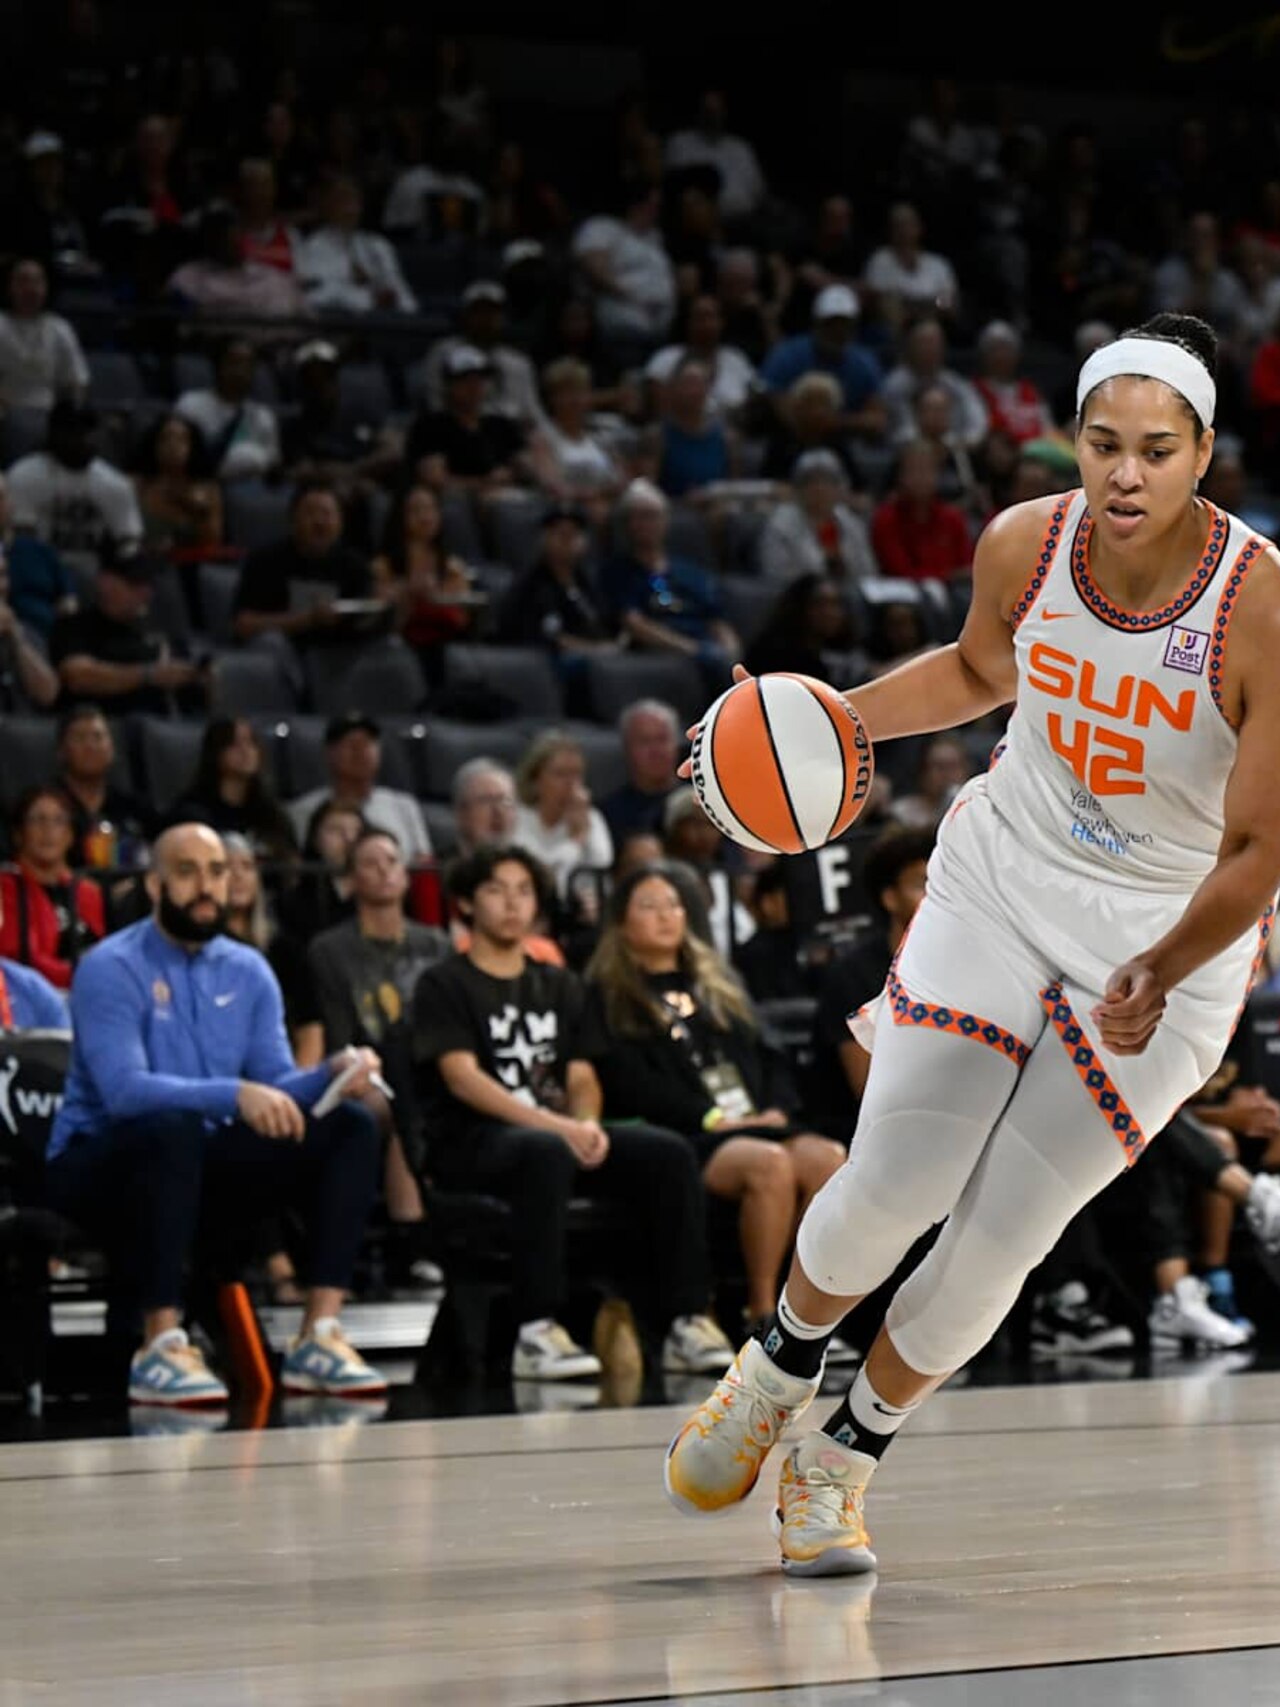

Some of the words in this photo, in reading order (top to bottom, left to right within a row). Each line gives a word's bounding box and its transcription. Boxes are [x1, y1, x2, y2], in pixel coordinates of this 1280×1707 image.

[1171, 645, 1200, 665] Post
[1027, 642, 1196, 732] SUN
[1047, 712, 1146, 795] 42
[1070, 787, 1103, 812] Yale
